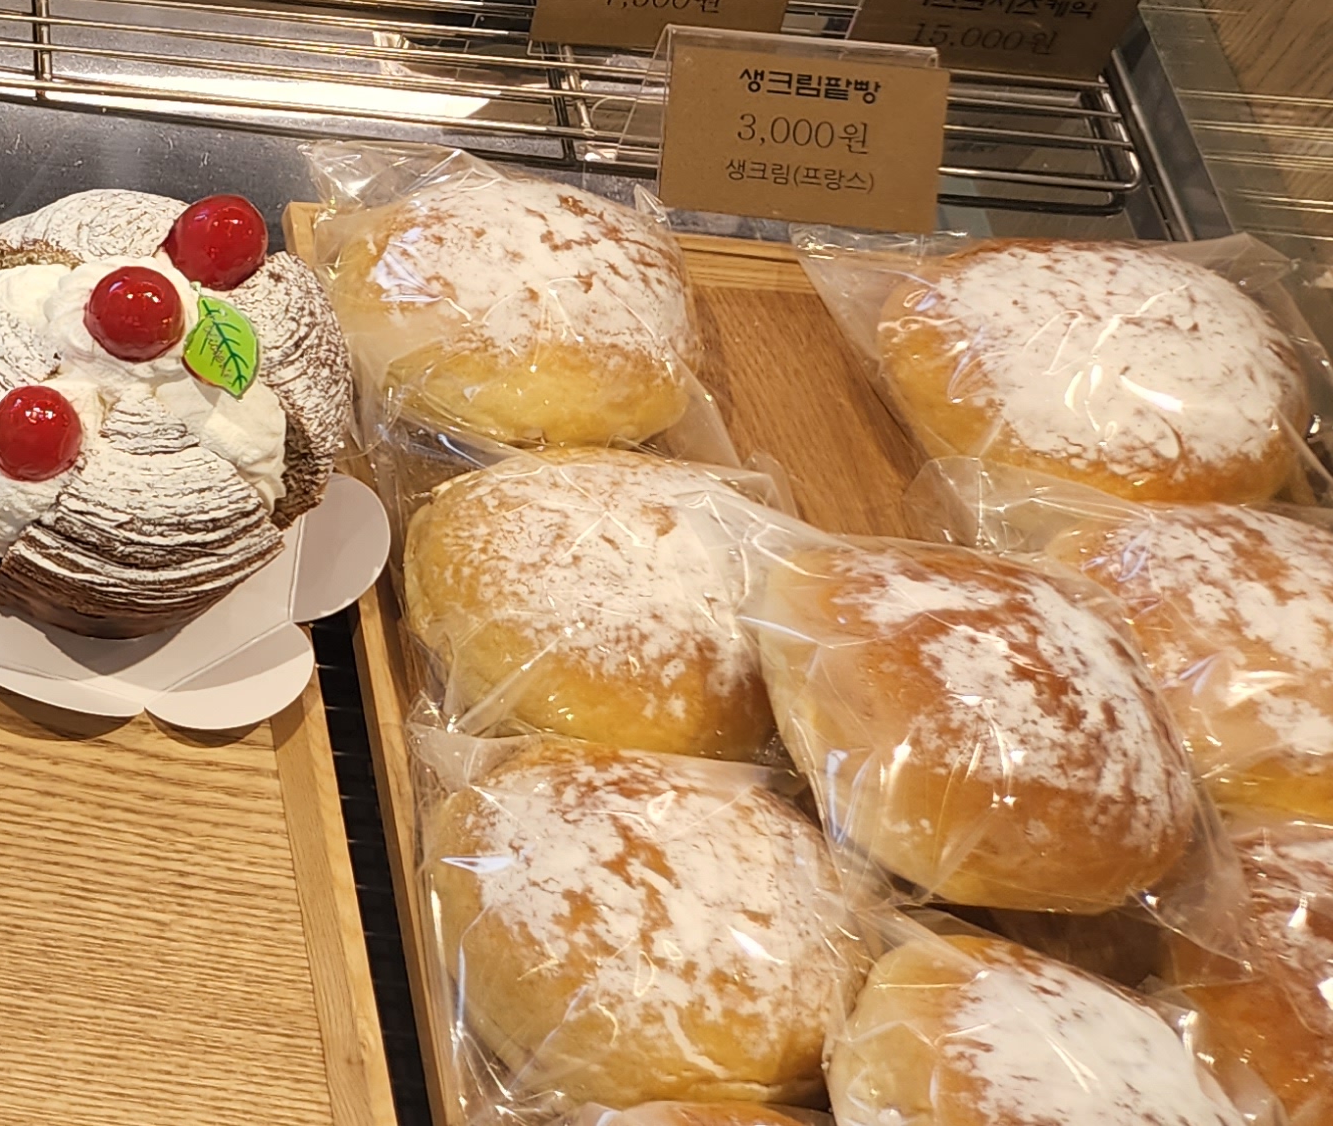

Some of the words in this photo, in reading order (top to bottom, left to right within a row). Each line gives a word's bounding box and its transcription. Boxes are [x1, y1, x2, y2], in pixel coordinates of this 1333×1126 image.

[739, 68, 882, 105] 생크림팥빵
[737, 113, 869, 155] 3,000원
[725, 158, 874, 194] 생크림(프랑스)
